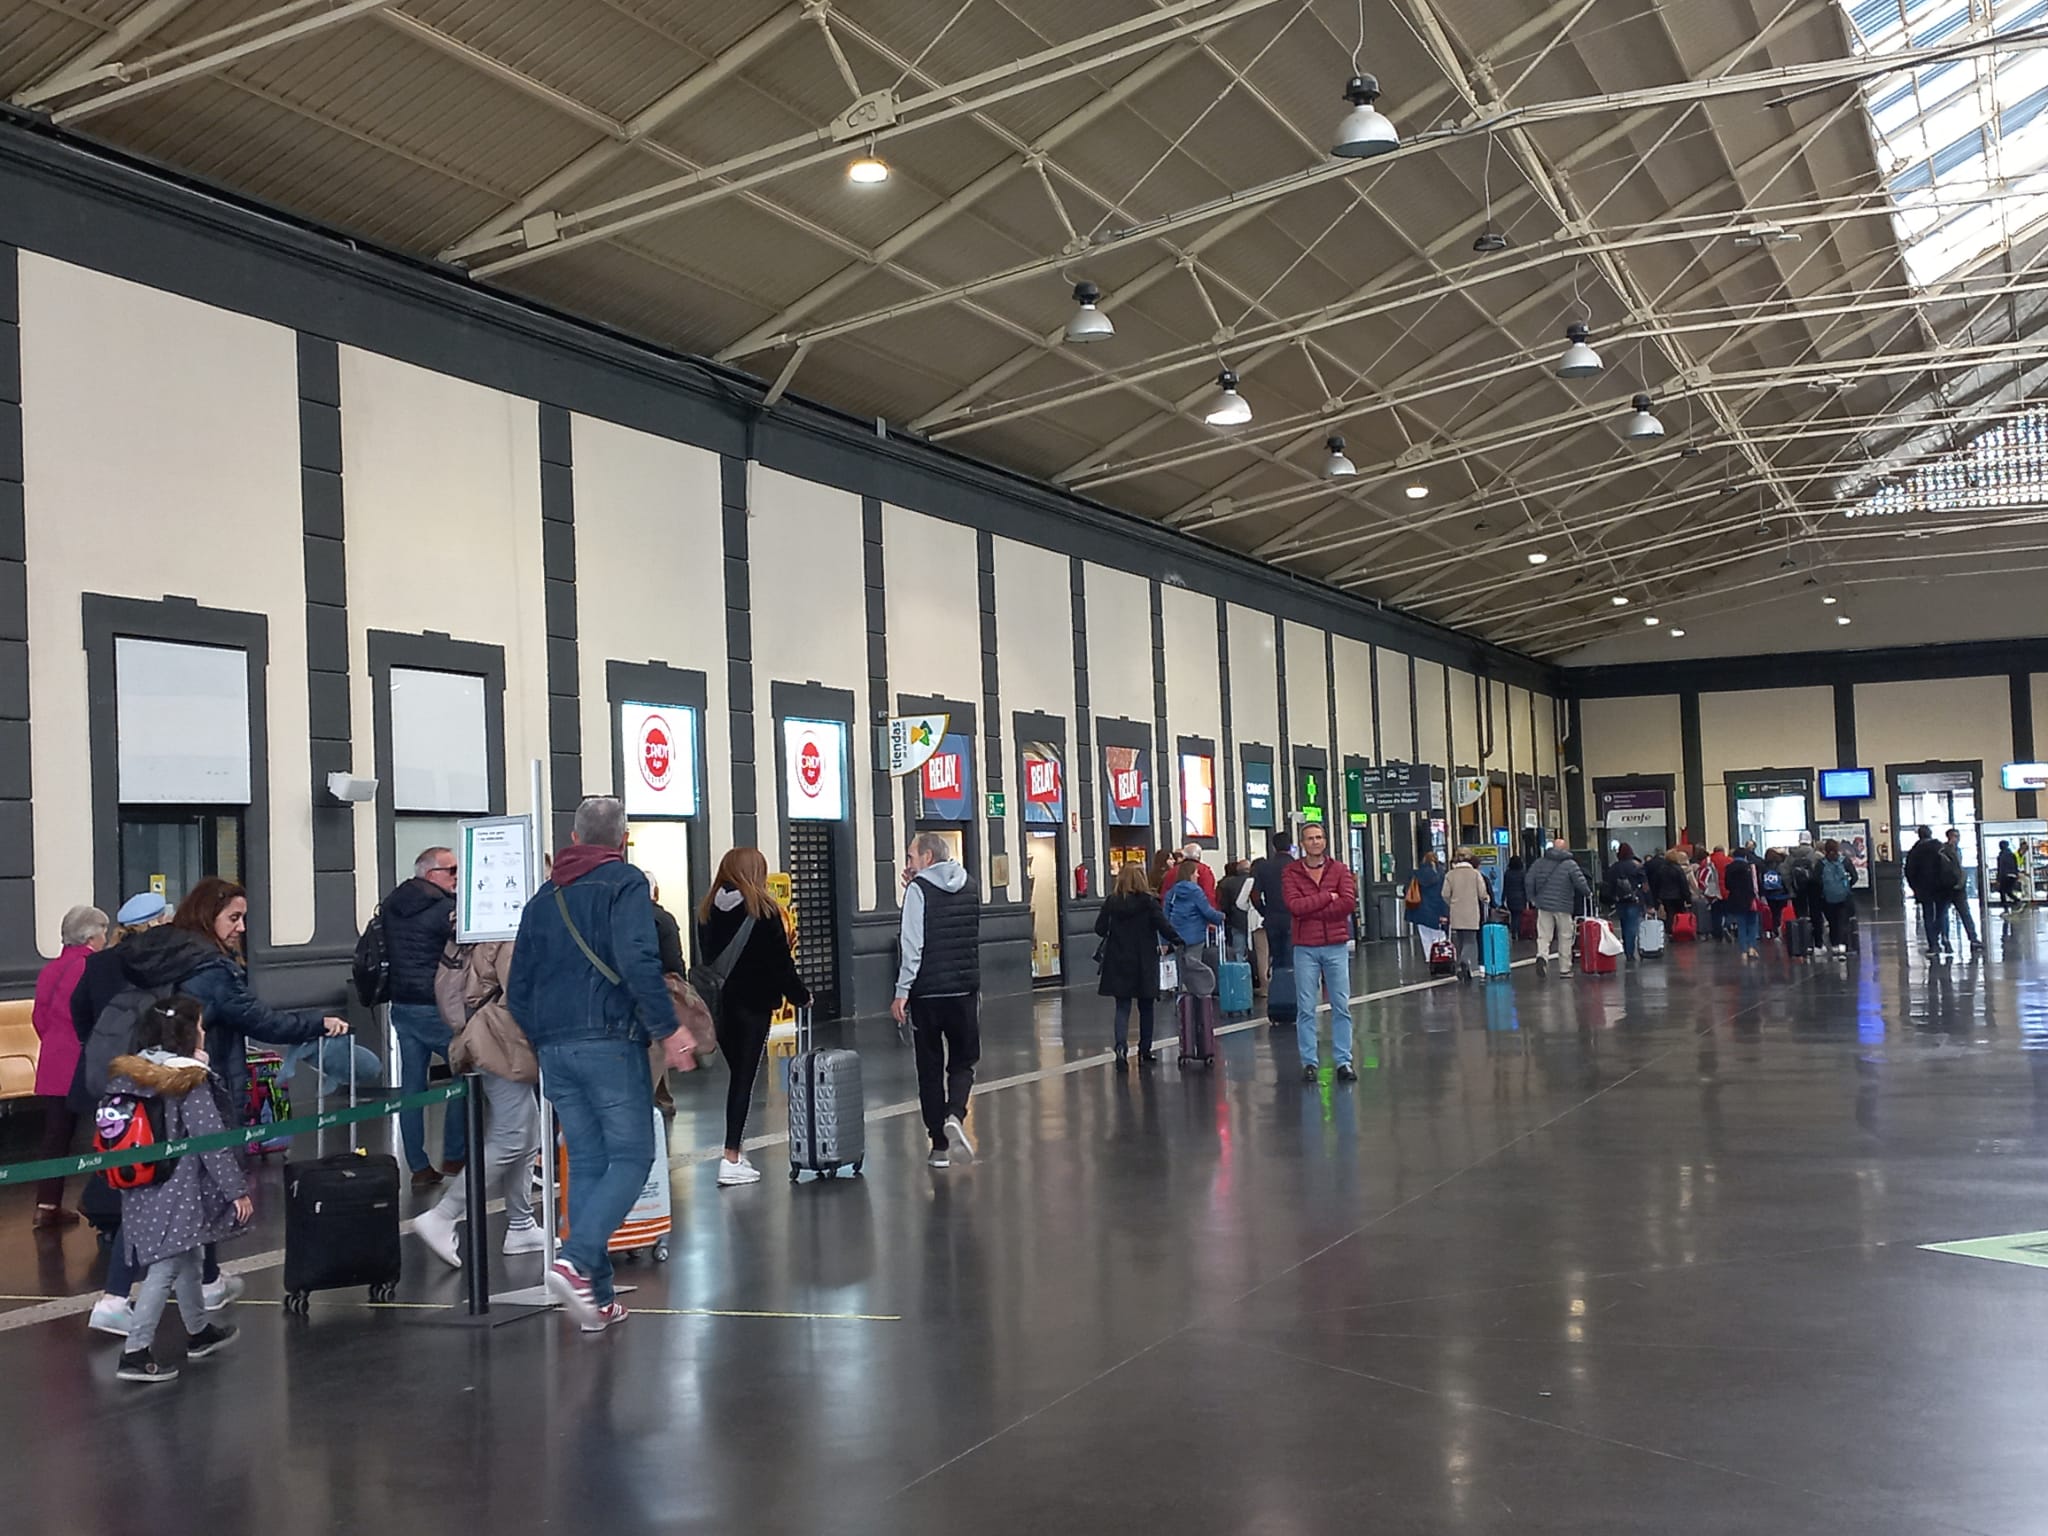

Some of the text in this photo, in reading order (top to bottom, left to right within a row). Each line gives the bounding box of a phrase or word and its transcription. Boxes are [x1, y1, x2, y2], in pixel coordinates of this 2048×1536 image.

[891, 721, 902, 769] tiendas
[928, 754, 956, 791] RELAY
[1030, 762, 1055, 795] RELAY
[1118, 770, 1138, 801] RELAY
[1621, 813, 1652, 824] renfe
